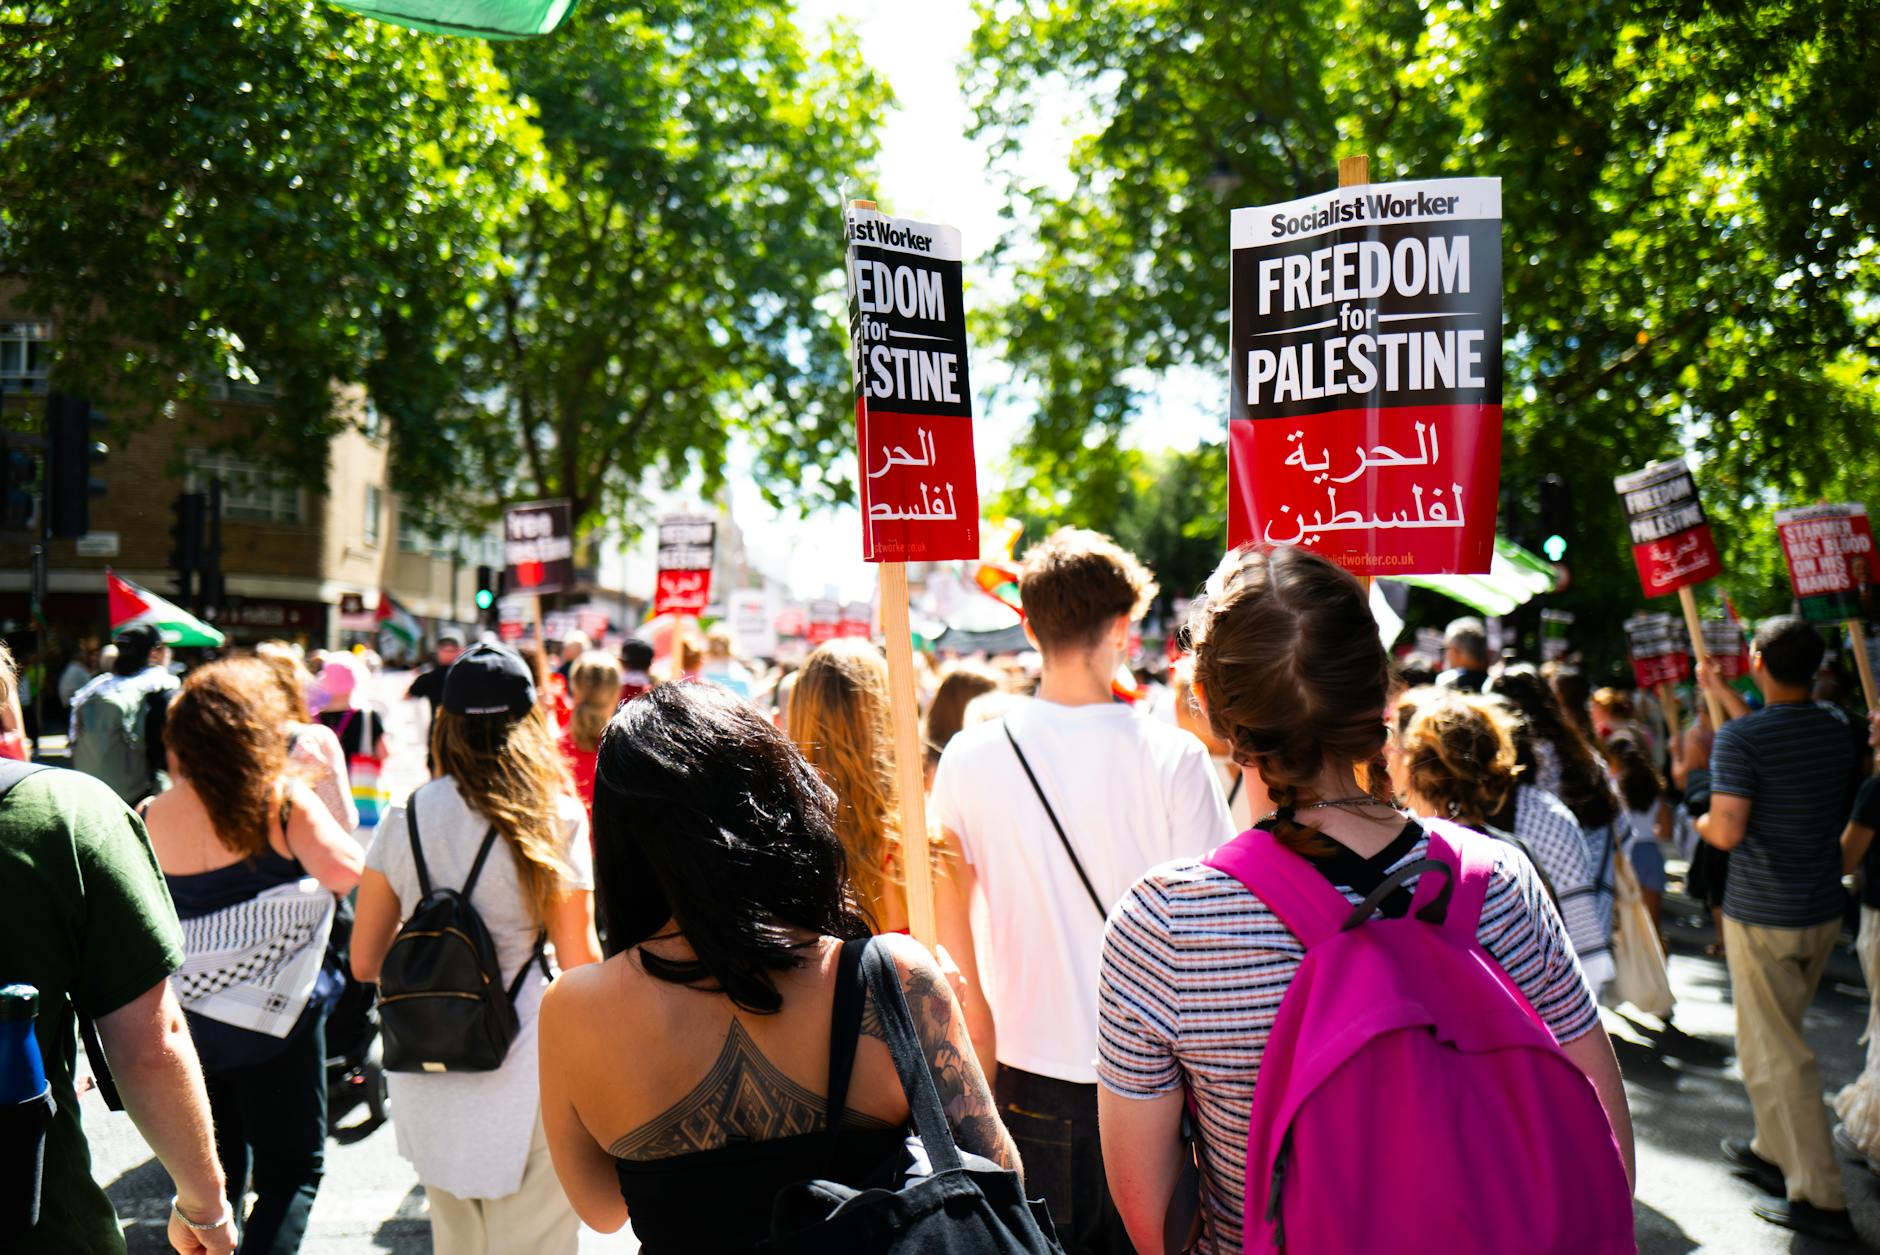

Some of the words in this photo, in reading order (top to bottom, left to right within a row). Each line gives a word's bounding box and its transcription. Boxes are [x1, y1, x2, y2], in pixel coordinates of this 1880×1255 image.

[875, 220, 933, 252] Worker
[1271, 196, 1365, 238] Socialist
[1365, 191, 1460, 220] Worker
[854, 259, 946, 322] EDOM
[1258, 235, 1471, 315] FREEDOM
[862, 313, 889, 341] for
[1339, 302, 1376, 332] for
[1247, 329, 1485, 405] PALESTINE
[1284, 420, 1439, 485] الحرية
[1264, 482, 1465, 545] لفلسطين
